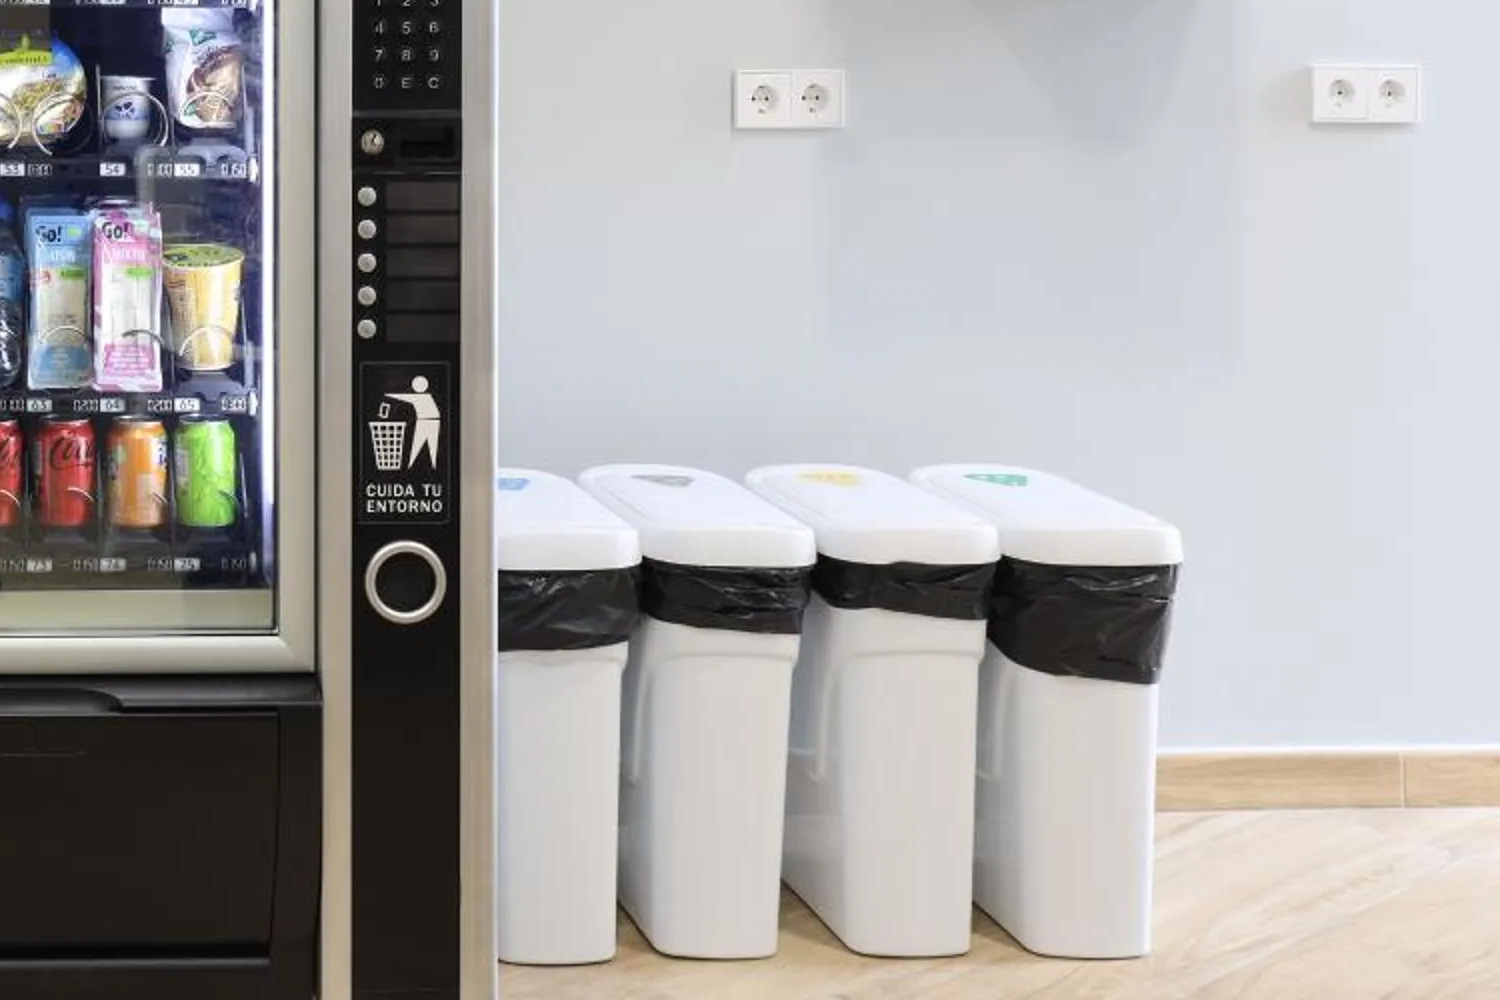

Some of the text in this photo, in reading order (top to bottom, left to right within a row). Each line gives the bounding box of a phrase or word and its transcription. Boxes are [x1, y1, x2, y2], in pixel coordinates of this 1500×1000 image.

[403, 21, 411, 34] 5
[402, 49, 411, 61] 8
[429, 49, 439, 61] 9
[401, 77, 412, 89] E
[427, 77, 439, 89] C
[102, 222, 129, 238] Go!
[366, 483, 441, 497] CUIDA TU
[367, 500, 443, 514] ENTORNO
